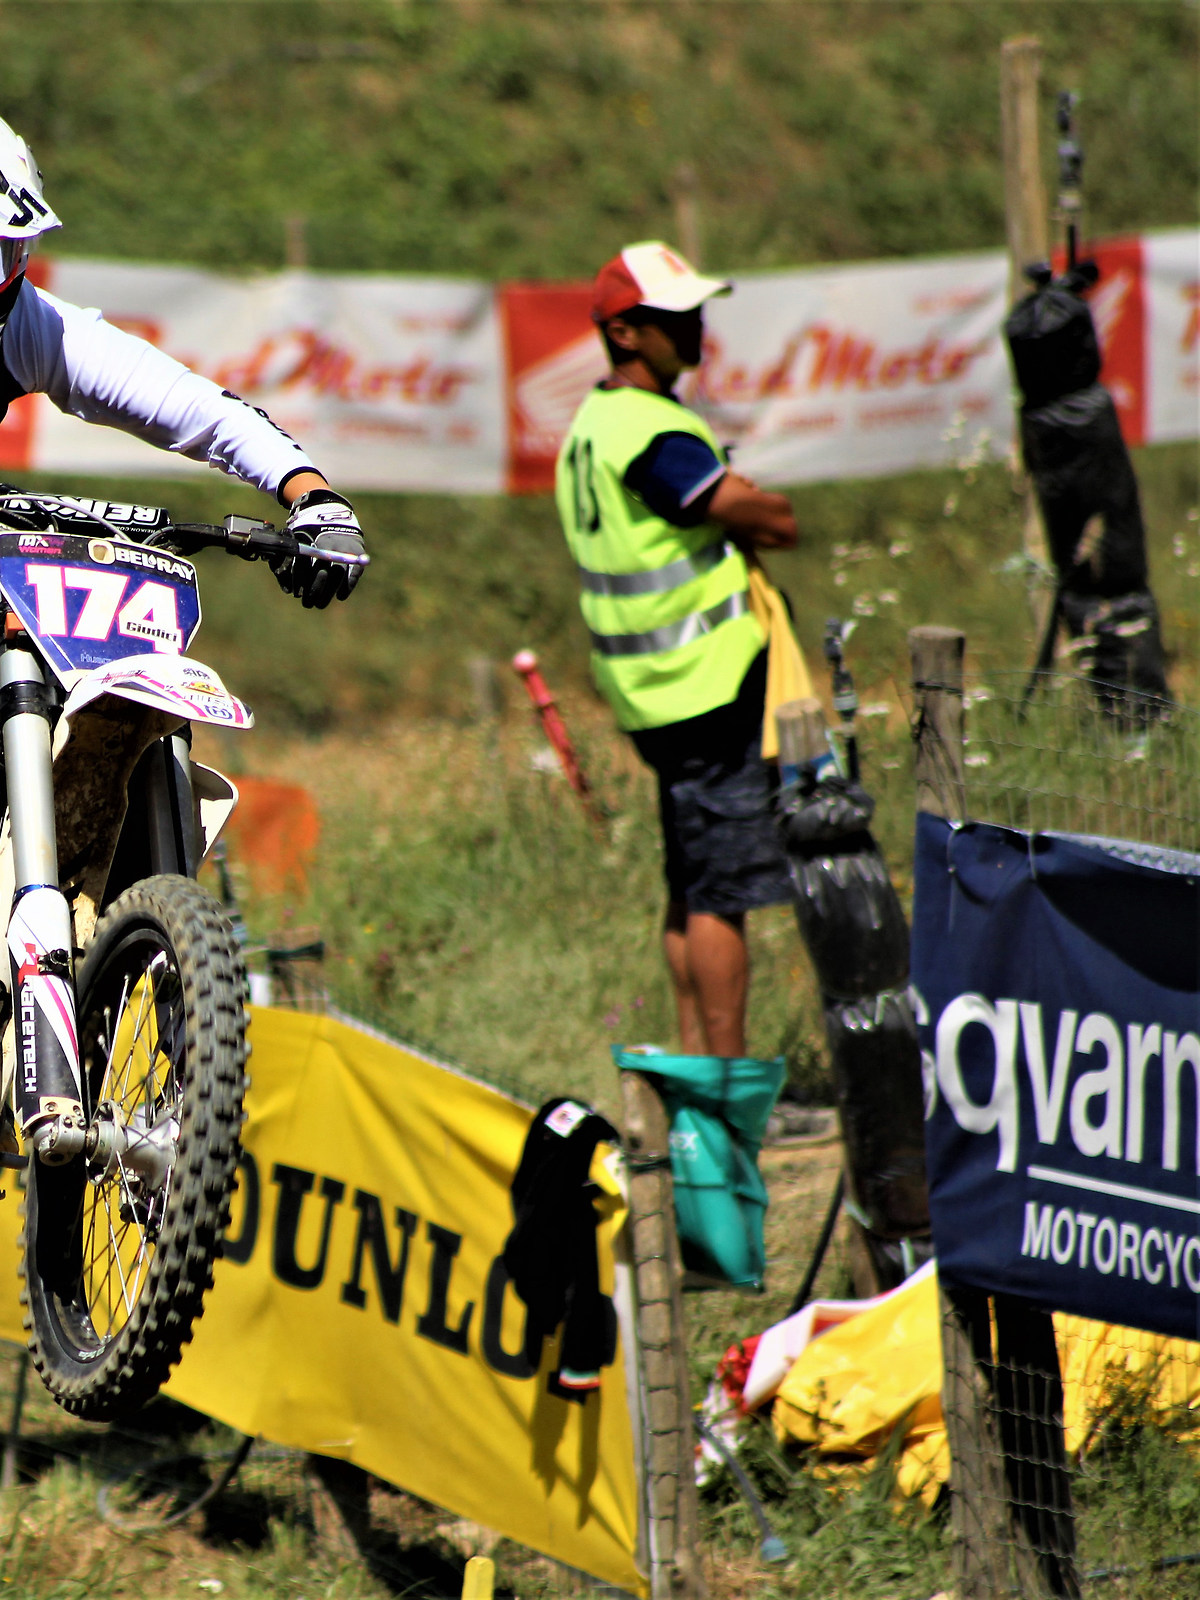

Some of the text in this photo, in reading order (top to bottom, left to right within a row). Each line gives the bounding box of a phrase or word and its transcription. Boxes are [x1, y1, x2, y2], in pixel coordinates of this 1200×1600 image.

[24, 563, 183, 656] 174
[126, 621, 178, 643] Giudici
[220, 1152, 617, 1404] DUNLO
